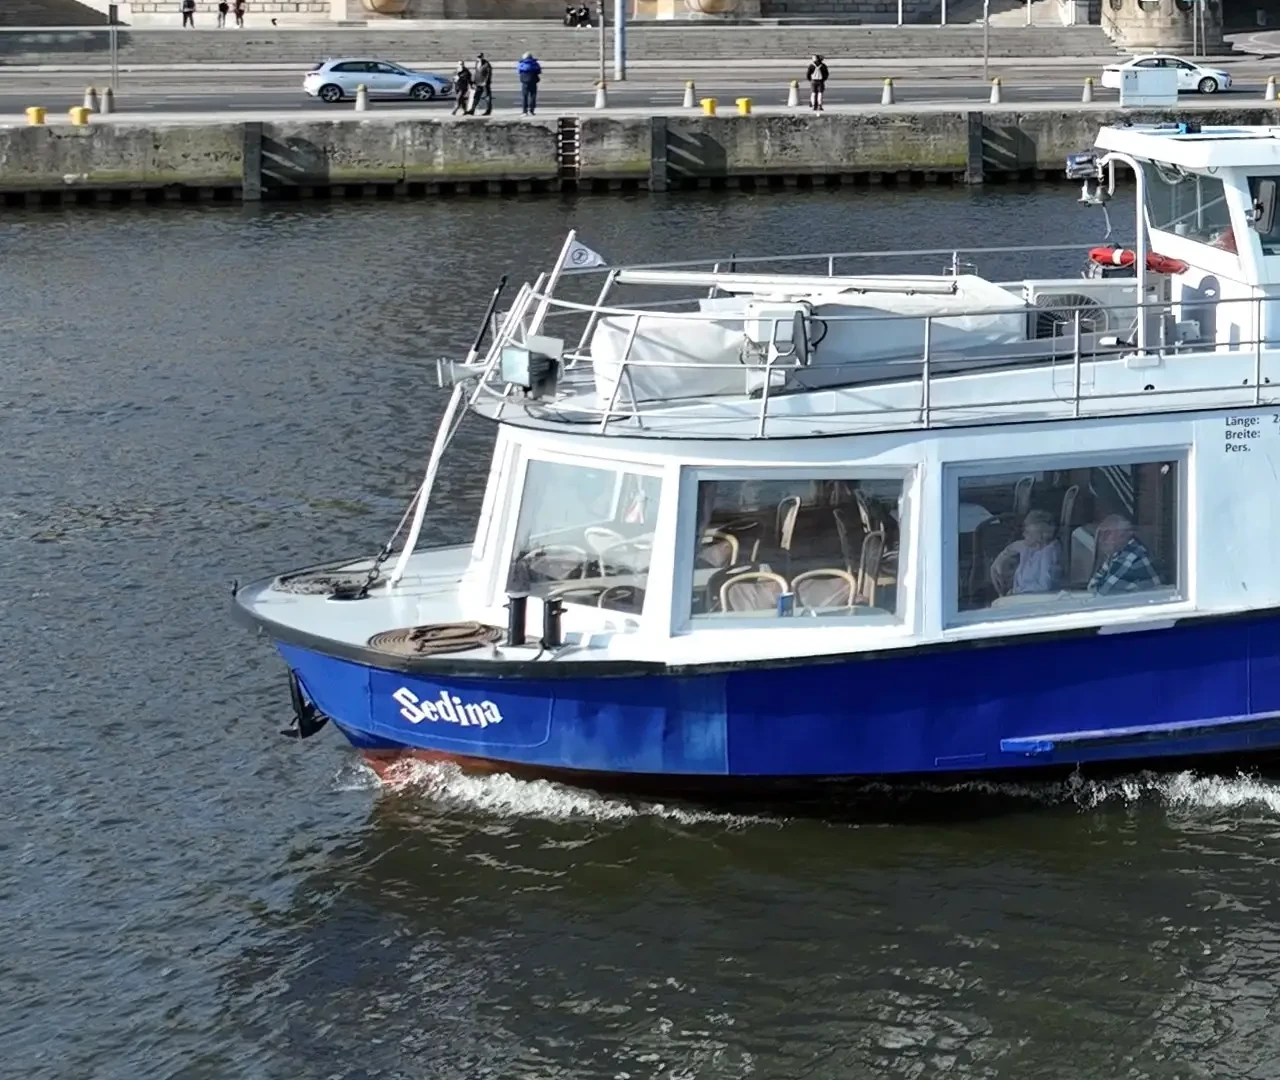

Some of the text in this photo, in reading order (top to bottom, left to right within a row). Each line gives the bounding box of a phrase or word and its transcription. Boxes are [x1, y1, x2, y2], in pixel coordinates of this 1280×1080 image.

[1225, 416, 1260, 428] Länge:
[1225, 429, 1260, 439] Breite:
[1225, 443, 1251, 452] Pers.
[392, 686, 503, 729] Sedina
